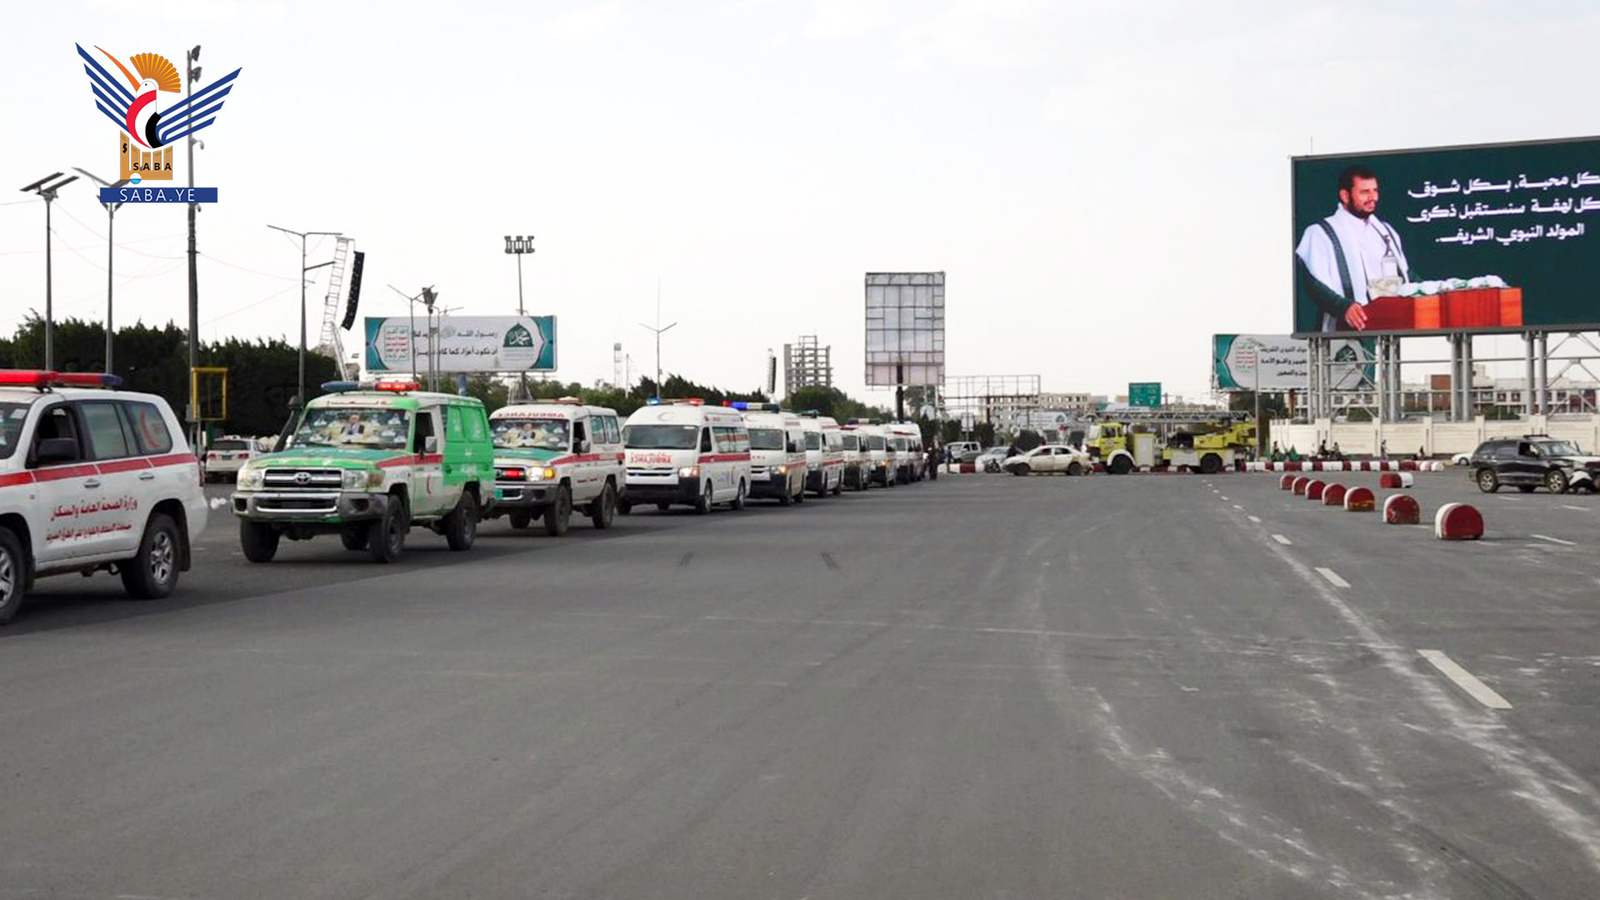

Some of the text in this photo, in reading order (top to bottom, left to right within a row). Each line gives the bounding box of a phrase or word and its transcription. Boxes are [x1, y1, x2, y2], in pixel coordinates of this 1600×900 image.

[1462, 178, 1512, 195] بكل
[1570, 171, 1600, 188] كل
[1406, 196, 1600, 223] كل لهفة سنستقبل ذكرى
[1435, 222, 1585, 246] المولد النبوي الشريف.
